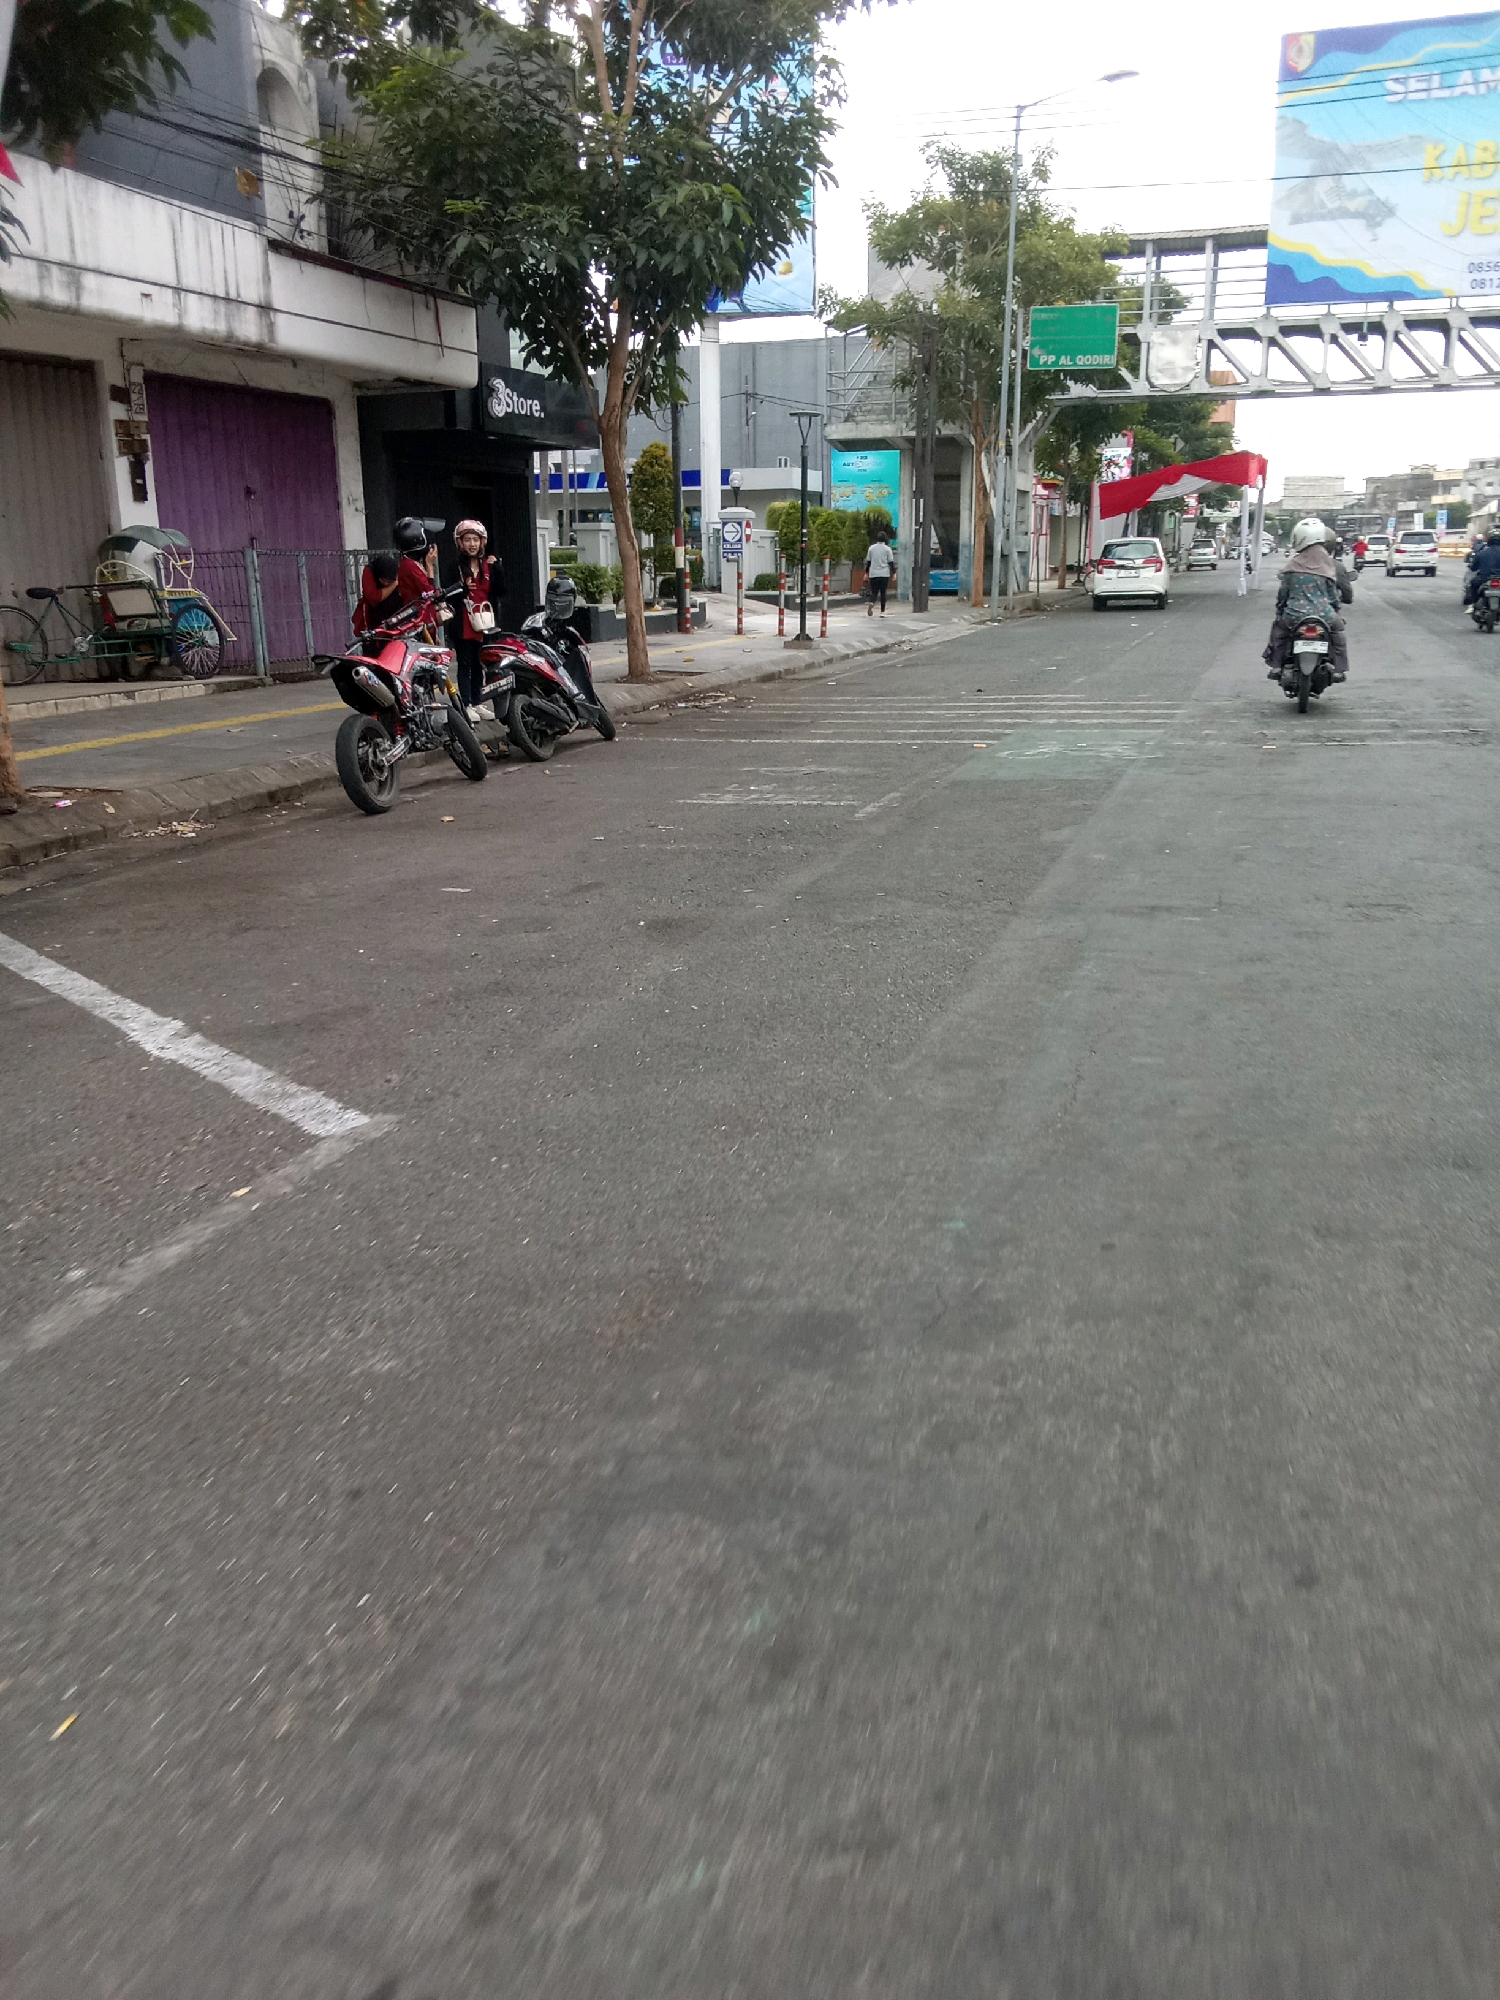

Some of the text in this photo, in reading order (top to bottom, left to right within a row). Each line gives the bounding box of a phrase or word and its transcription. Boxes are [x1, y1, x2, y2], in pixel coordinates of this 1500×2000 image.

[1423, 139, 1498, 183] KAB
[1039, 354, 1116, 365] PP AL QODIRI
